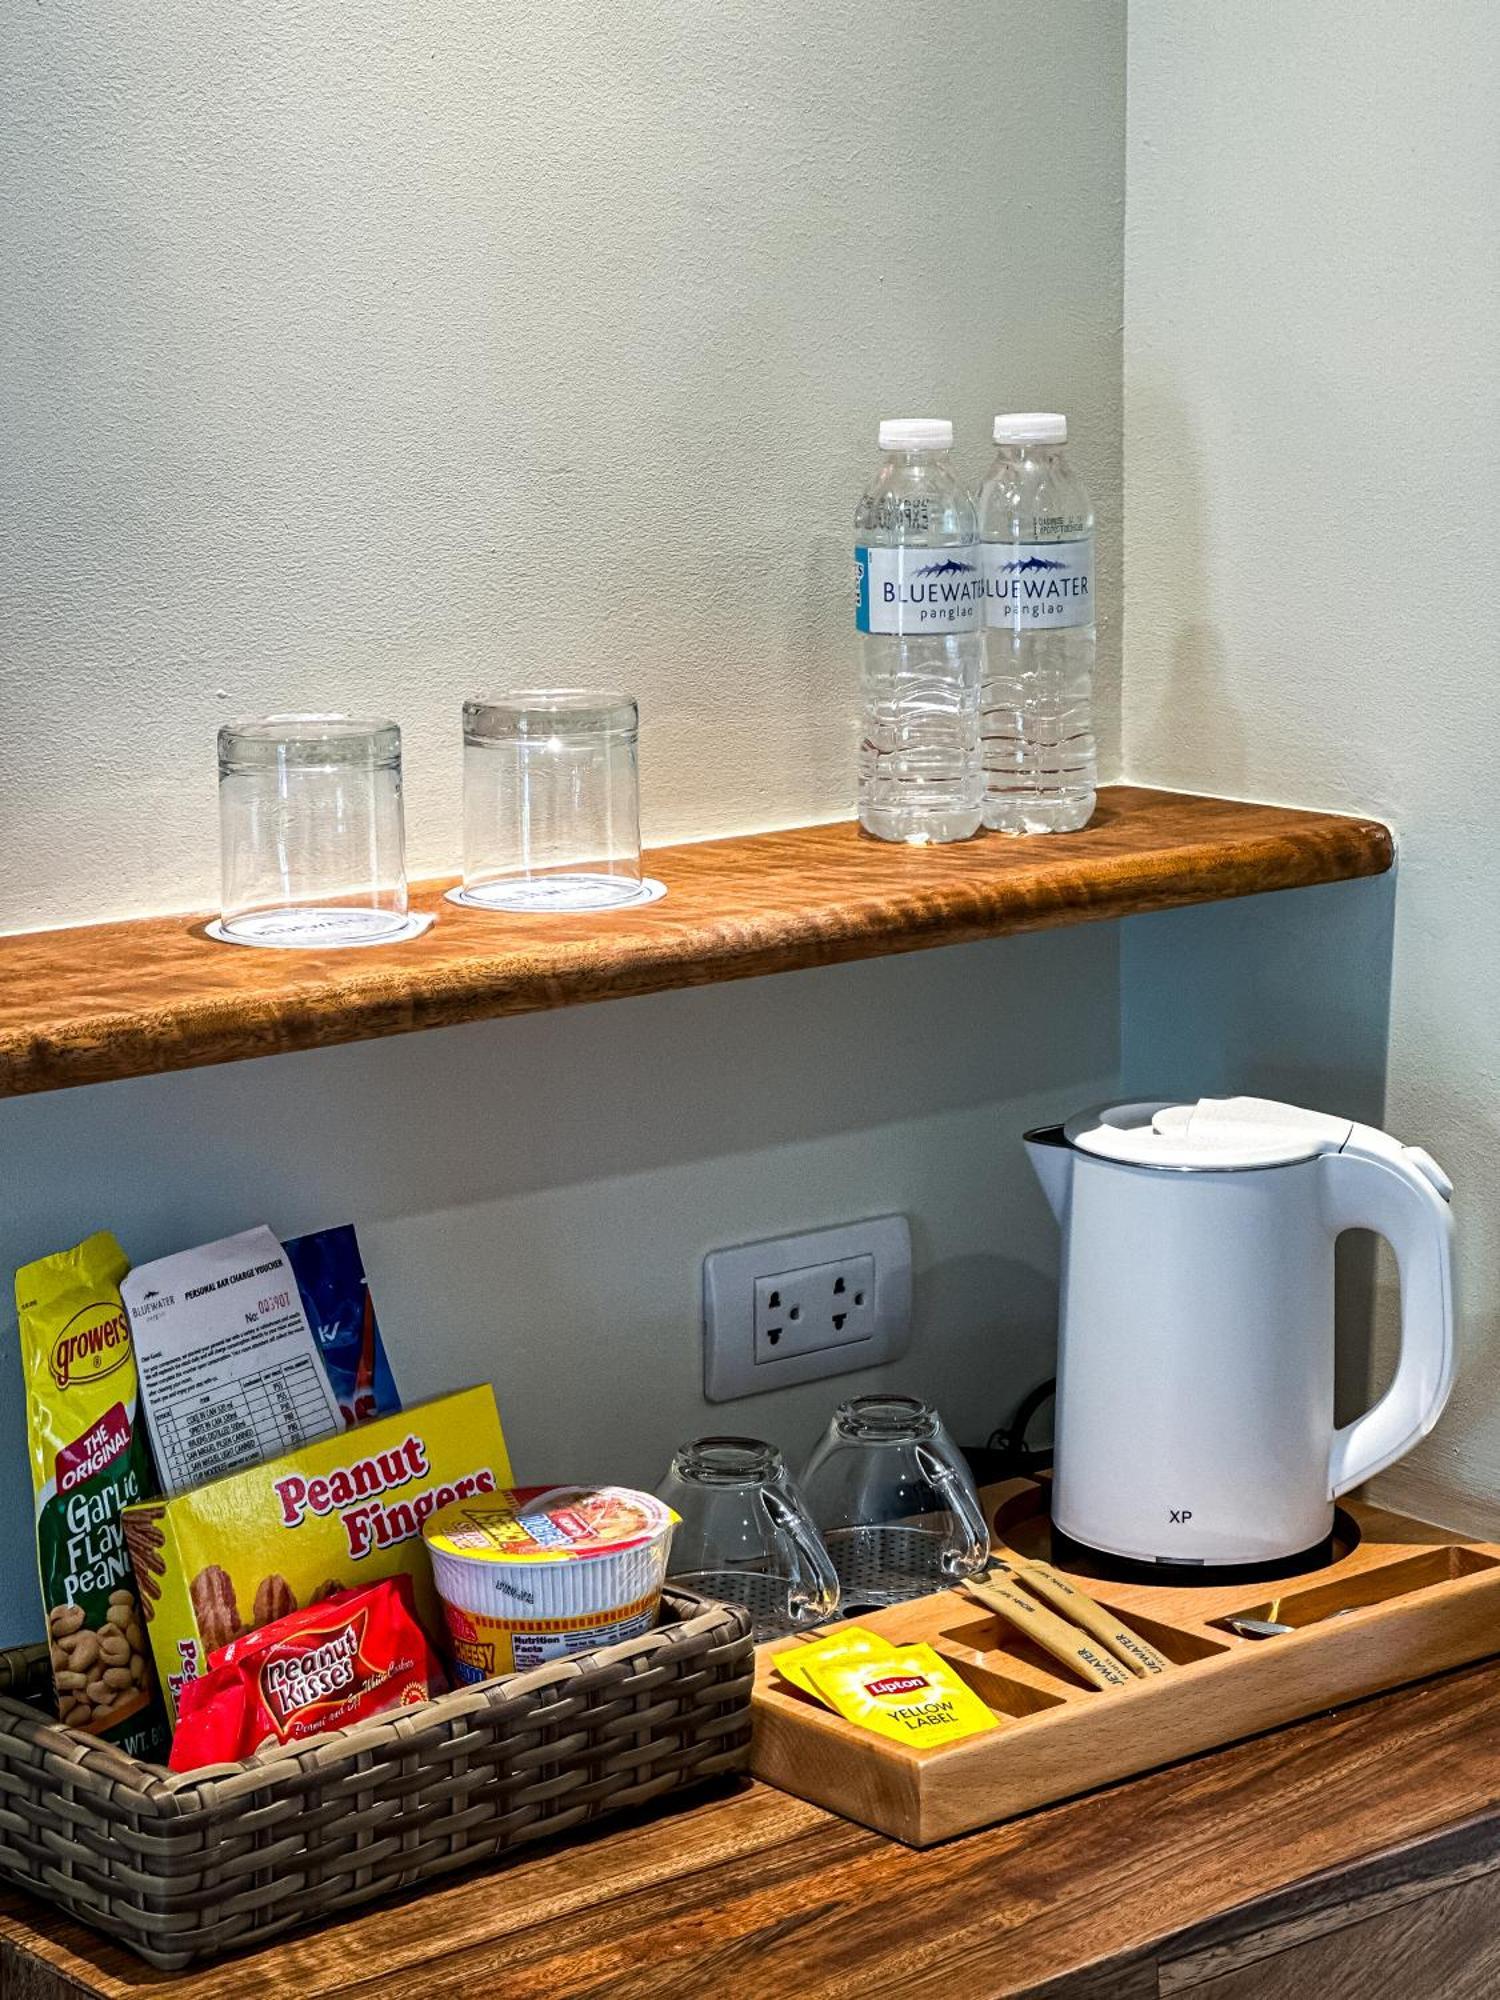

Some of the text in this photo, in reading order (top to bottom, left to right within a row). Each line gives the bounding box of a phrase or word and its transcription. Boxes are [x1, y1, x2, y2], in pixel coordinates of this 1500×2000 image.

[883, 579, 985, 603] BLUEWAT
[184, 1258, 283, 1300] PERSONAL BAR CHARGE VOUCHER
[131, 1296, 175, 1318] BLUEWATER
[56, 1312, 130, 1386] growers
[83, 1423, 109, 1456] THE
[62, 1427, 131, 1491] ORIGINAL
[275, 1436, 427, 1523] Peanut
[342, 1470, 495, 1556] Fingers
[1168, 1509, 1193, 1524] XP
[514, 1635, 561, 1645] Nutrition
[514, 1645, 543, 1653] Facts
[268, 1624, 358, 1692] Peanut
[278, 1658, 354, 1715] Kisses
[869, 1676, 924, 1694] Lipton
[886, 1700, 954, 1721] YELLOW
[904, 1713, 959, 1731] LABEL
